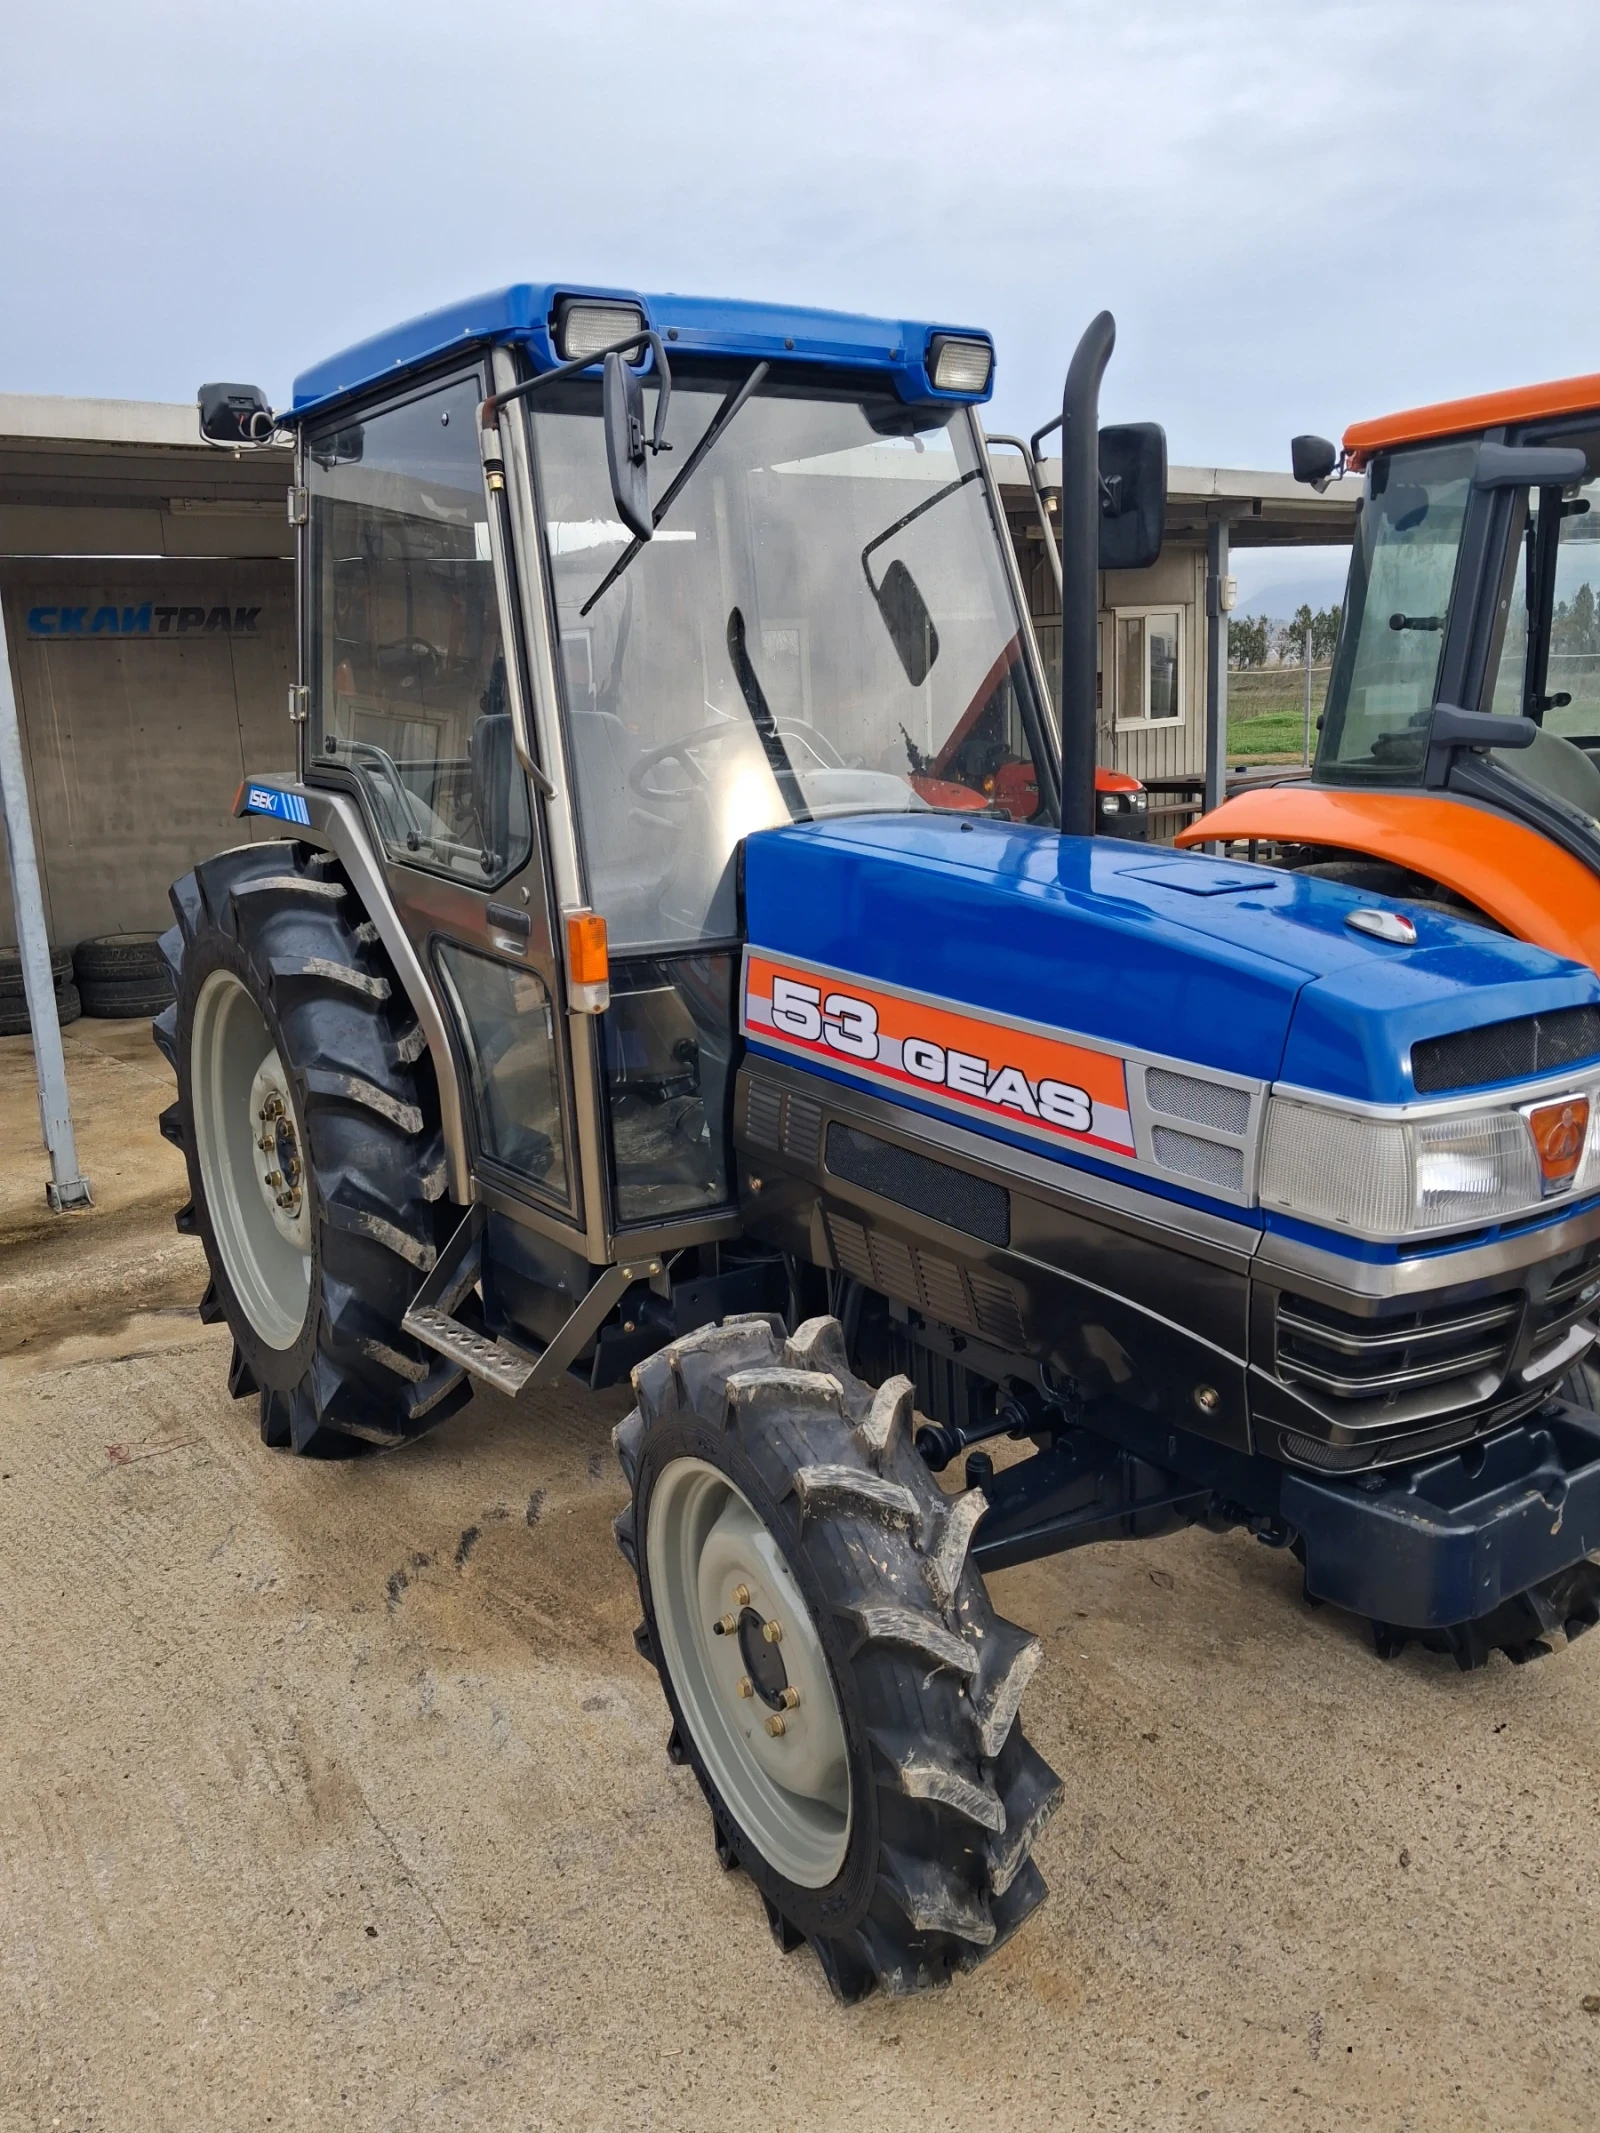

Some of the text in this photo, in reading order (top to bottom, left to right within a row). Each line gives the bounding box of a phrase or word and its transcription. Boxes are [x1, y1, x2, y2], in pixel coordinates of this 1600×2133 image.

[248, 788, 279, 812] ISEKI
[771, 975, 1093, 1133] 53 GEAS
